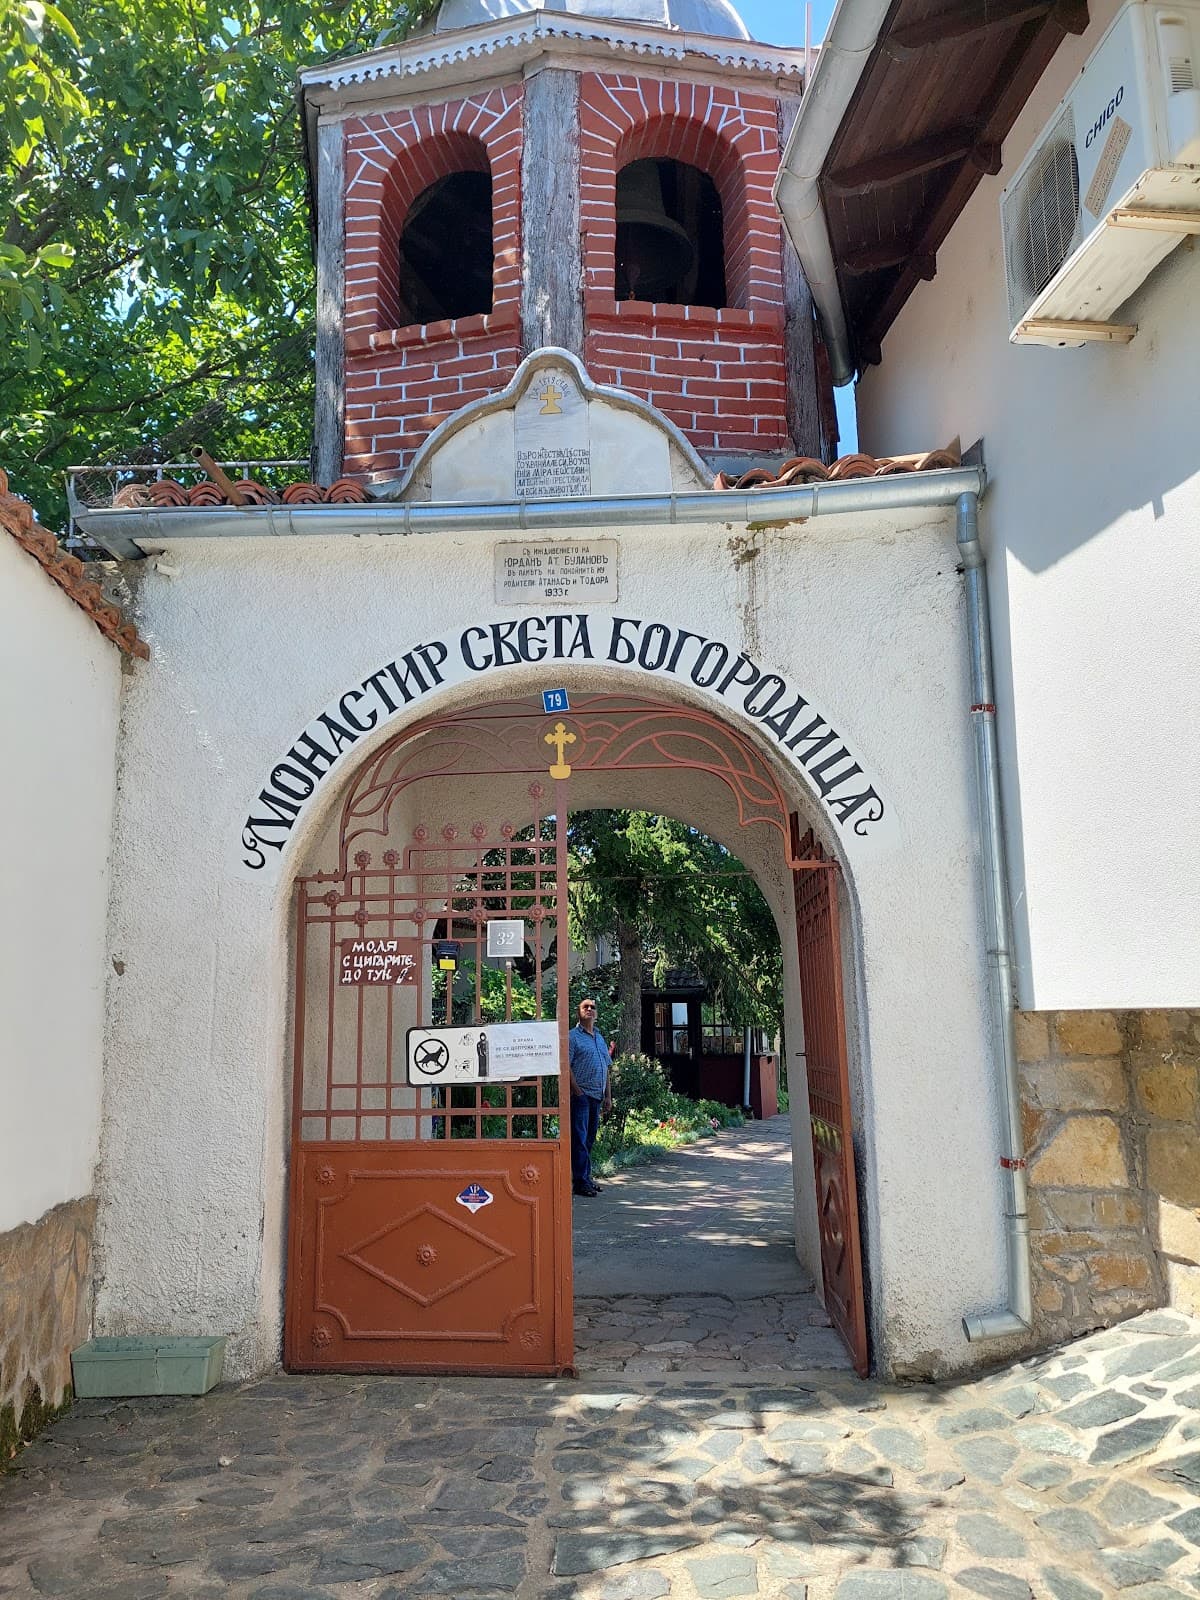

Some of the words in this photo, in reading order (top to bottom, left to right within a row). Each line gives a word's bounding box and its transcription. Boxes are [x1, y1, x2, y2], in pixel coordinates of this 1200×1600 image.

[1085, 85, 1124, 149] CHIGO
[504, 557, 542, 568] ЮРДАНЪ
[564, 554, 609, 566] БУЛАНОВЪ
[544, 588, 563, 597] 1933
[547, 693, 562, 708] 79
[242, 641, 448, 870] МОНАСТИР
[607, 617, 885, 836] БОГОРОДИЦА
[496, 931, 514, 946] 32
[352, 940, 398, 954] МОЛЯ
[342, 955, 351, 967] С
[341, 969, 362, 984] ДО
